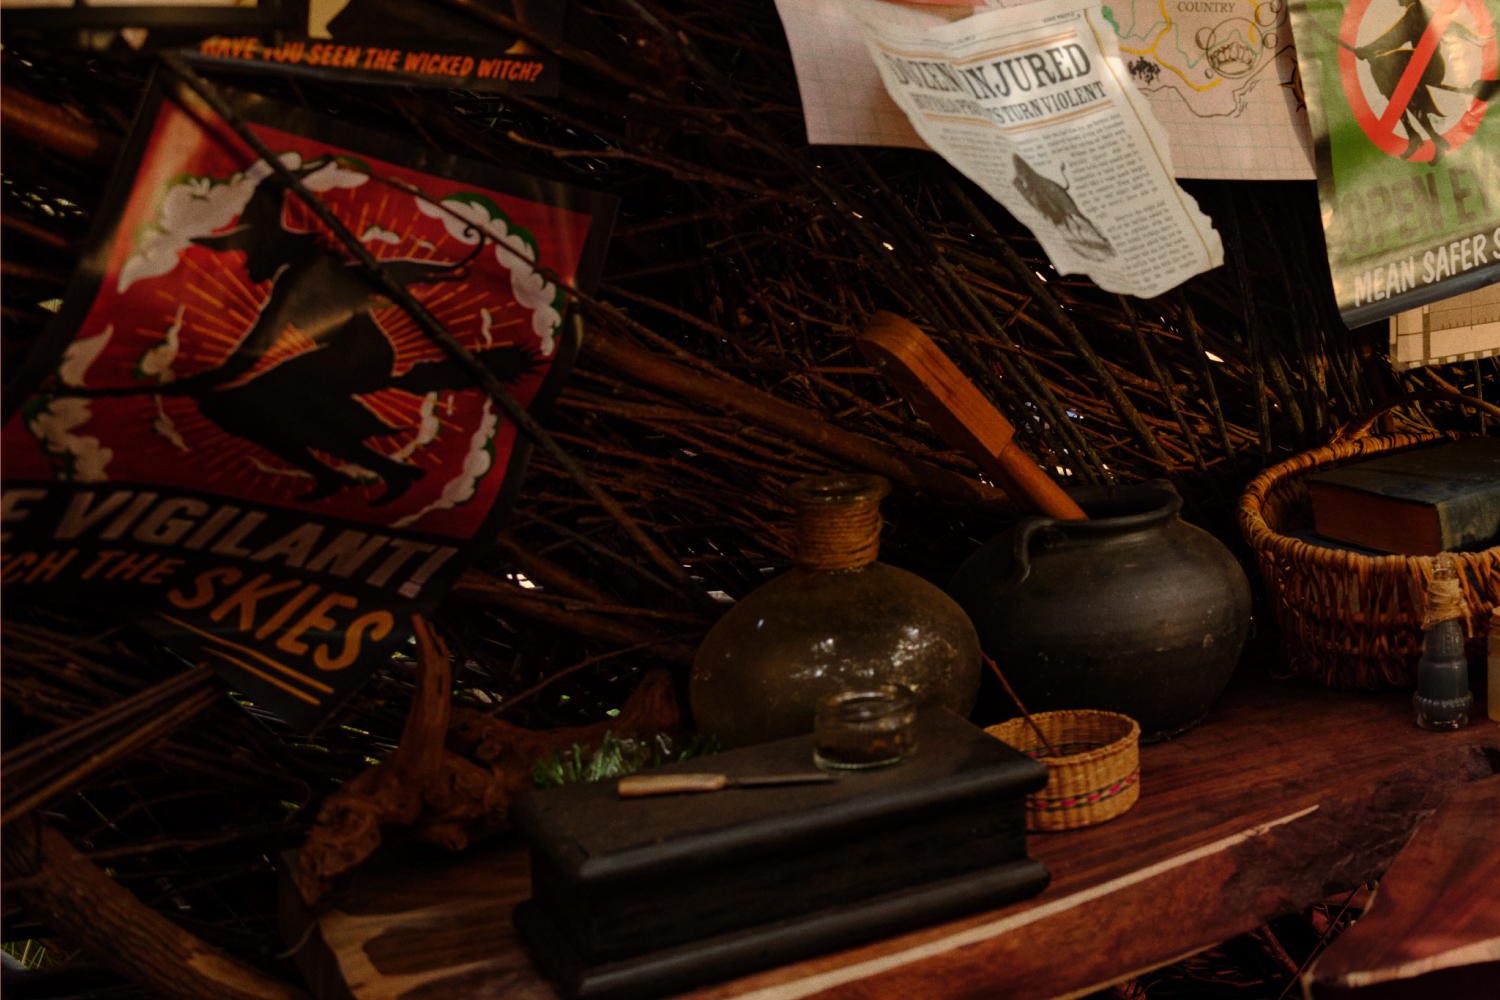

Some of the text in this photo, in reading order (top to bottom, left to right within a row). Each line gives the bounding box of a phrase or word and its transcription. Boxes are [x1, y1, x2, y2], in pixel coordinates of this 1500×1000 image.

[1176, 0, 1236, 14] COUNTRY
[200, 34, 259, 60] HAVE
[305, 43, 362, 68] SEEN
[363, 46, 401, 71] THE
[402, 50, 475, 77] WICKED
[477, 57, 544, 83] WITCH?
[959, 42, 1092, 101] INJURED
[1004, 101, 1043, 125] TURN
[1041, 81, 1108, 114] VIOLENT
[1340, 171, 1446, 252] OPEN
[1353, 256, 1416, 308] MEAN
[1421, 233, 1488, 285] SAFER
[52, 489, 460, 600] VIGILANT!
[80, 548, 187, 585] THE
[166, 566, 395, 672] SKIES
